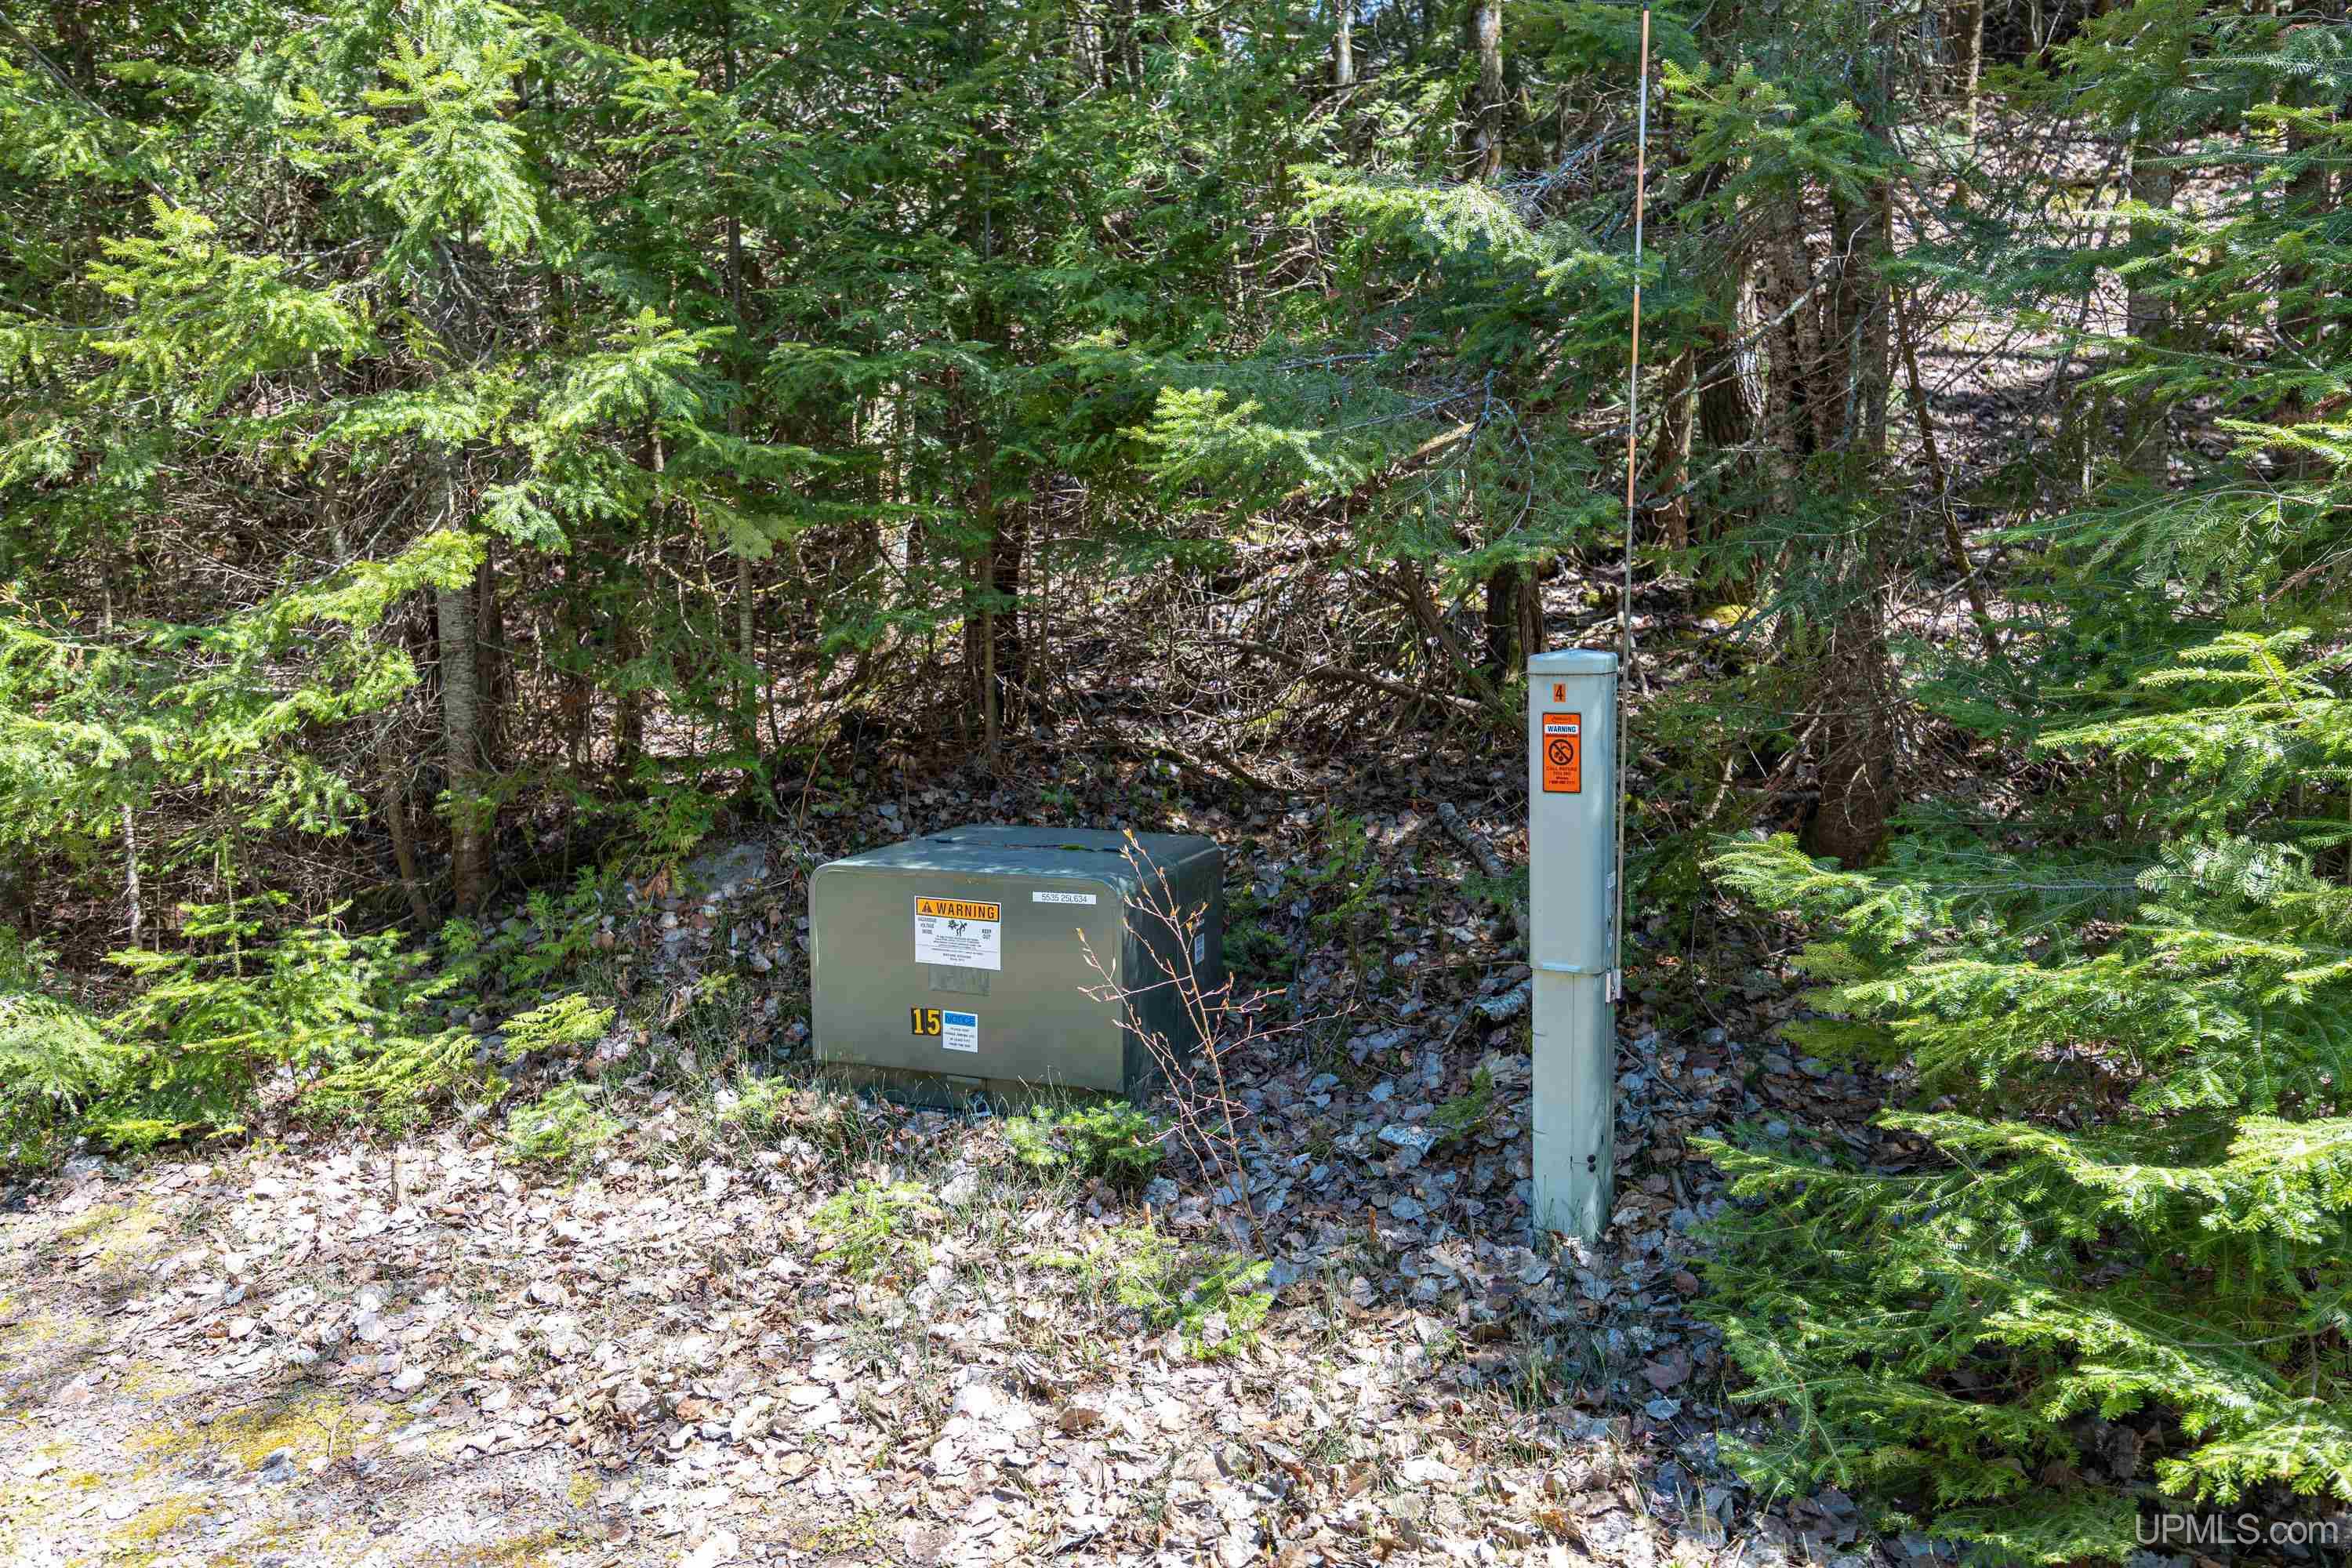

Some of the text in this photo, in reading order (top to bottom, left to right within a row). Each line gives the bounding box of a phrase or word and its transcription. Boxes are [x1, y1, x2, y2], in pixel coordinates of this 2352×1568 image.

[1555, 684, 1563, 701] 4
[936, 902, 995, 920] WARNING
[913, 1008, 941, 1035] 15
[945, 1014, 975, 1025] NOTICE
